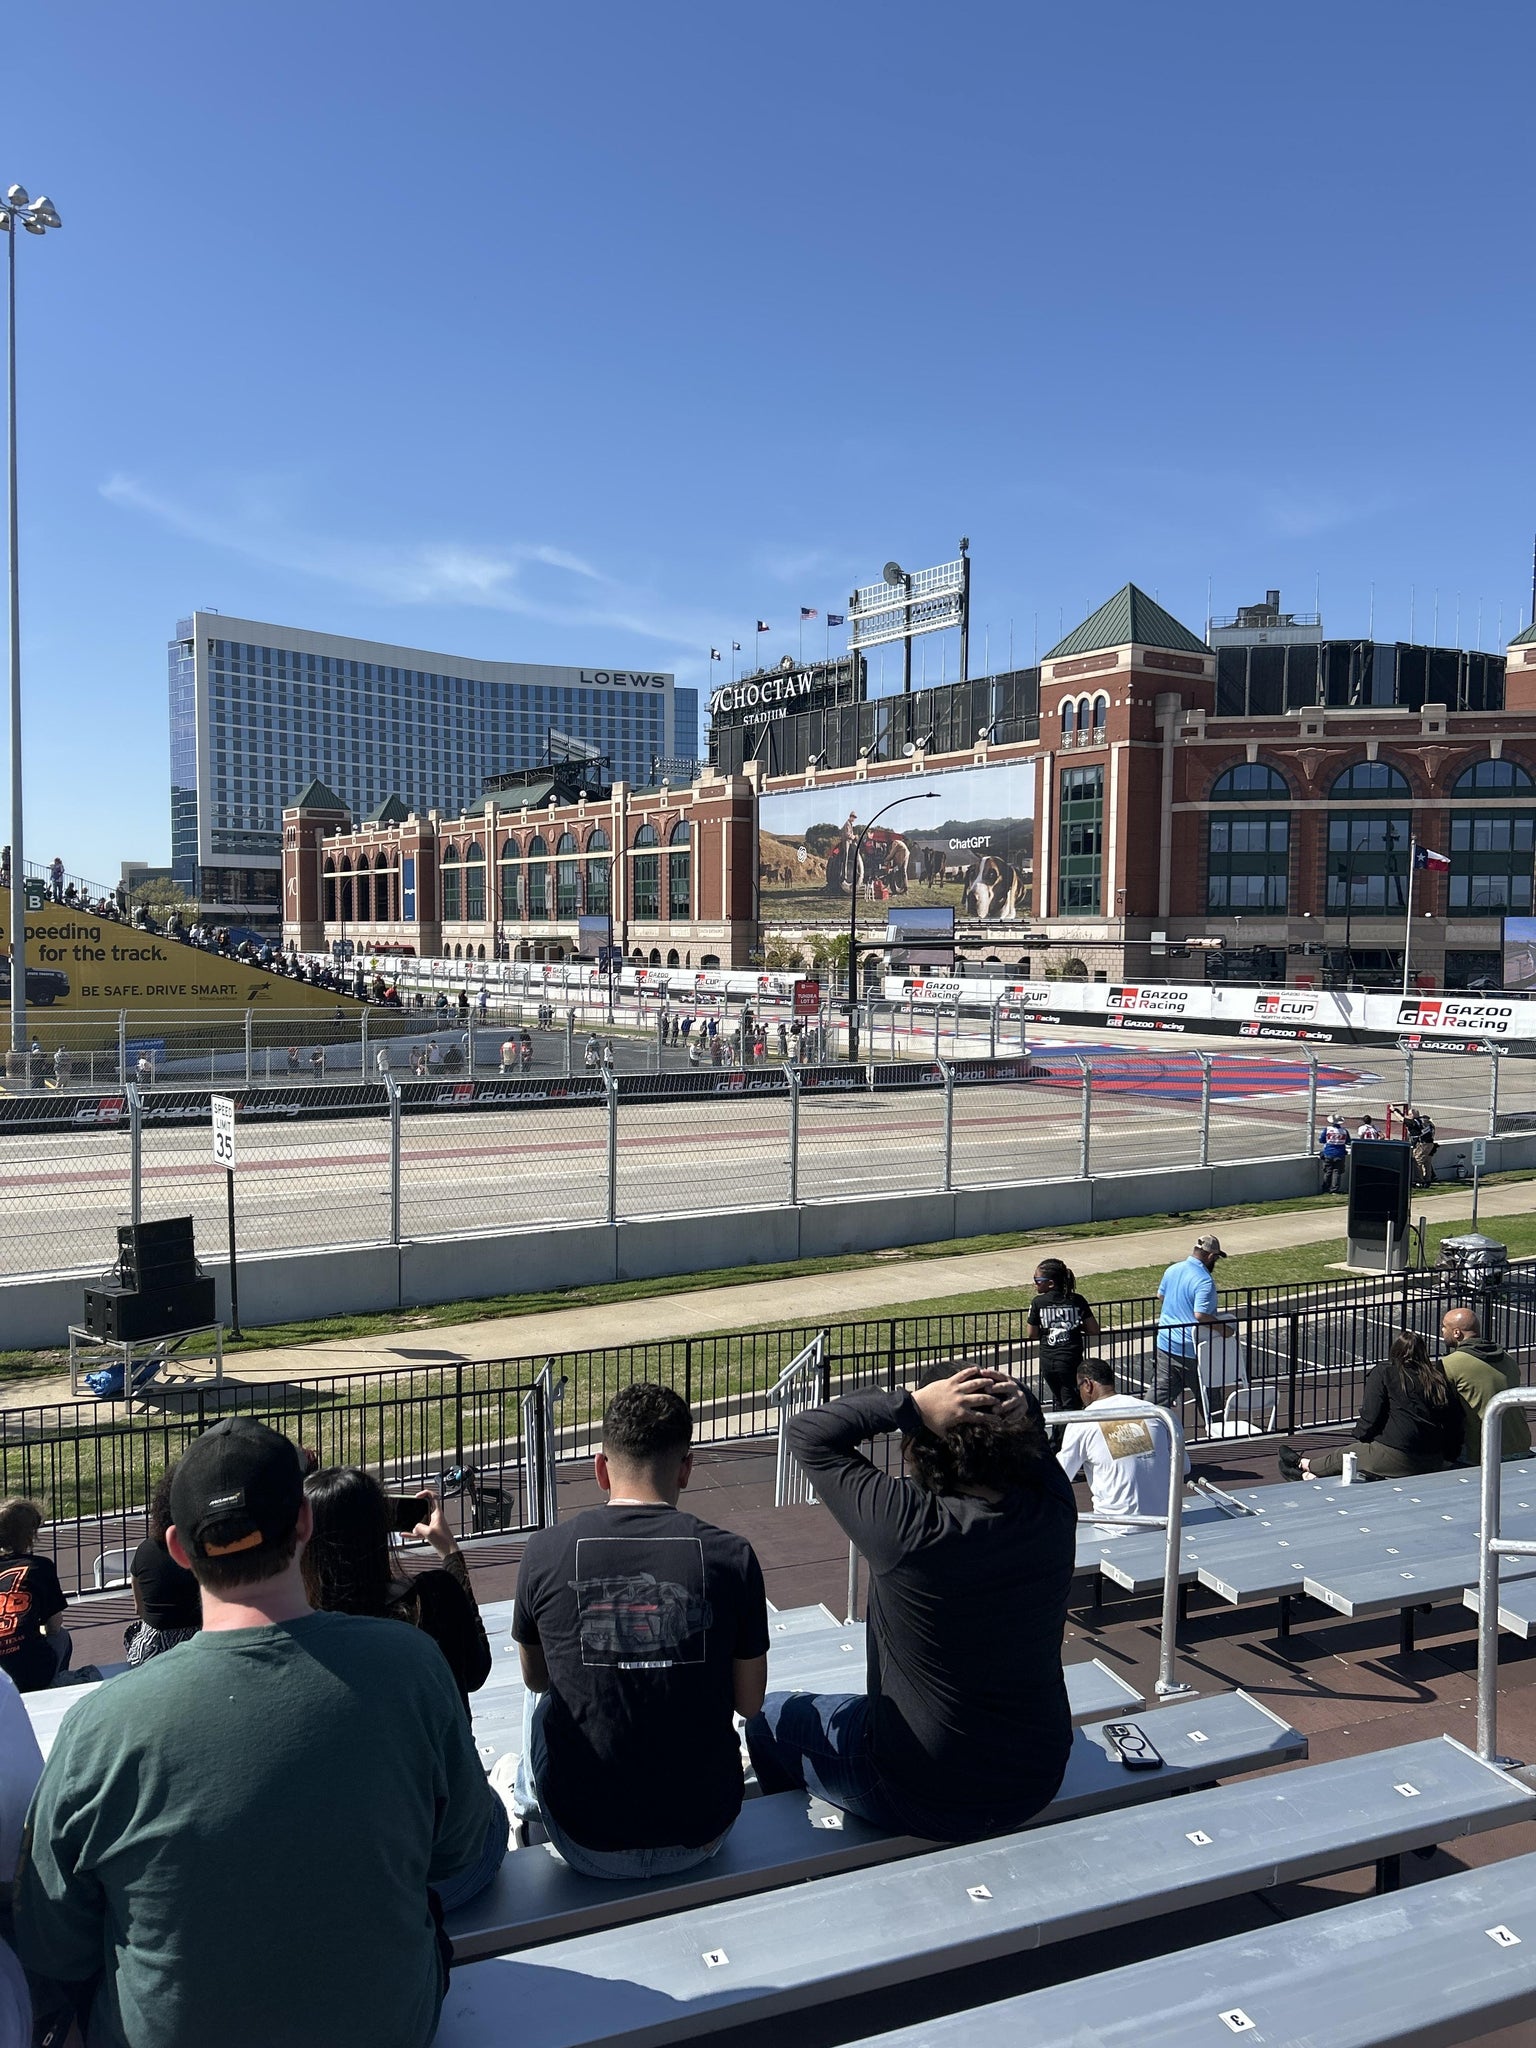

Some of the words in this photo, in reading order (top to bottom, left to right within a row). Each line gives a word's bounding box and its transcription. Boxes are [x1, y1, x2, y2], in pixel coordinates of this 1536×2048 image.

[580, 671, 664, 688] LOEWS
[720, 672, 814, 712] CHOCTAW
[744, 708, 788, 724] STADIUM
[949, 836, 991, 850] ChatGPT
[29, 896, 42, 908] B
[24, 923, 100, 942] peeding
[39, 945, 67, 961] for
[72, 945, 106, 961] the
[112, 945, 168, 961] track.
[82, 986, 100, 996] BE
[104, 986, 142, 996] SAFE.
[146, 985, 186, 996] DRIVE
[191, 984, 238, 995] SMART.
[926, 982, 960, 990] GAZOO
[1141, 990, 1188, 1000] GAZOO
[1139, 1000, 1185, 1012] Racing
[1254, 1002, 1278, 1014] GR
[1281, 1004, 1314, 1014] CUP
[1446, 1004, 1512, 1016] GAZOO
[1036, 1015, 1060, 1024] Racing
[1398, 1010, 1438, 1026] GR
[1442, 1016, 1508, 1032] Racing
[1124, 1020, 1154, 1028] GAZOO
[1155, 1022, 1185, 1031] Racing
[1240, 1026, 1258, 1035] GR
[1260, 1028, 1296, 1037] GAZOO
[1298, 1030, 1332, 1041] Racing
[1422, 1041, 1465, 1050] GAZOO
[955, 1070, 986, 1080] AZOO
[214, 1103, 232, 1118] SPEED
[216, 1118, 230, 1132] LIMIT
[216, 1132, 233, 1160] 35
[1496, 1931, 1510, 1941] 2
[711, 1954, 718, 1963] 4
[1230, 2014, 1245, 2026] 3
